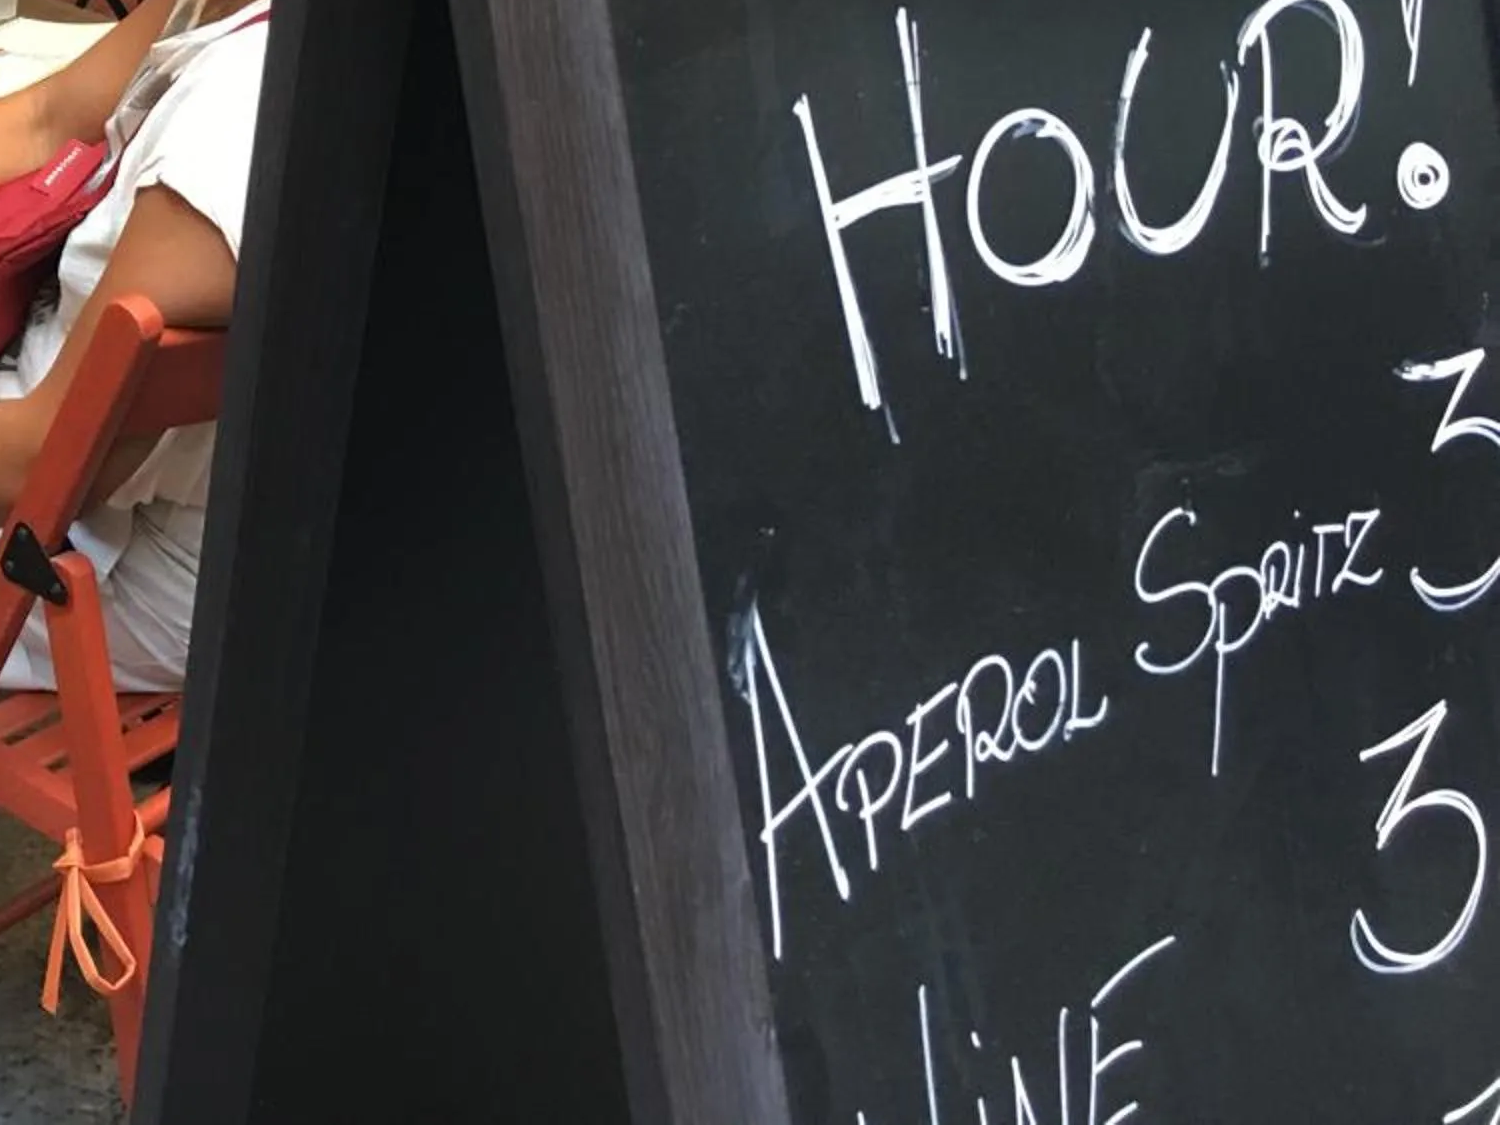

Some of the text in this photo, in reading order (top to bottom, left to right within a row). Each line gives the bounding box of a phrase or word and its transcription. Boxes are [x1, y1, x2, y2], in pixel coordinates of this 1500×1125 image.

[740, 597, 1109, 961] APEROL
[1393, 347, 1500, 612] 3
[1350, 699, 1488, 974] 3
